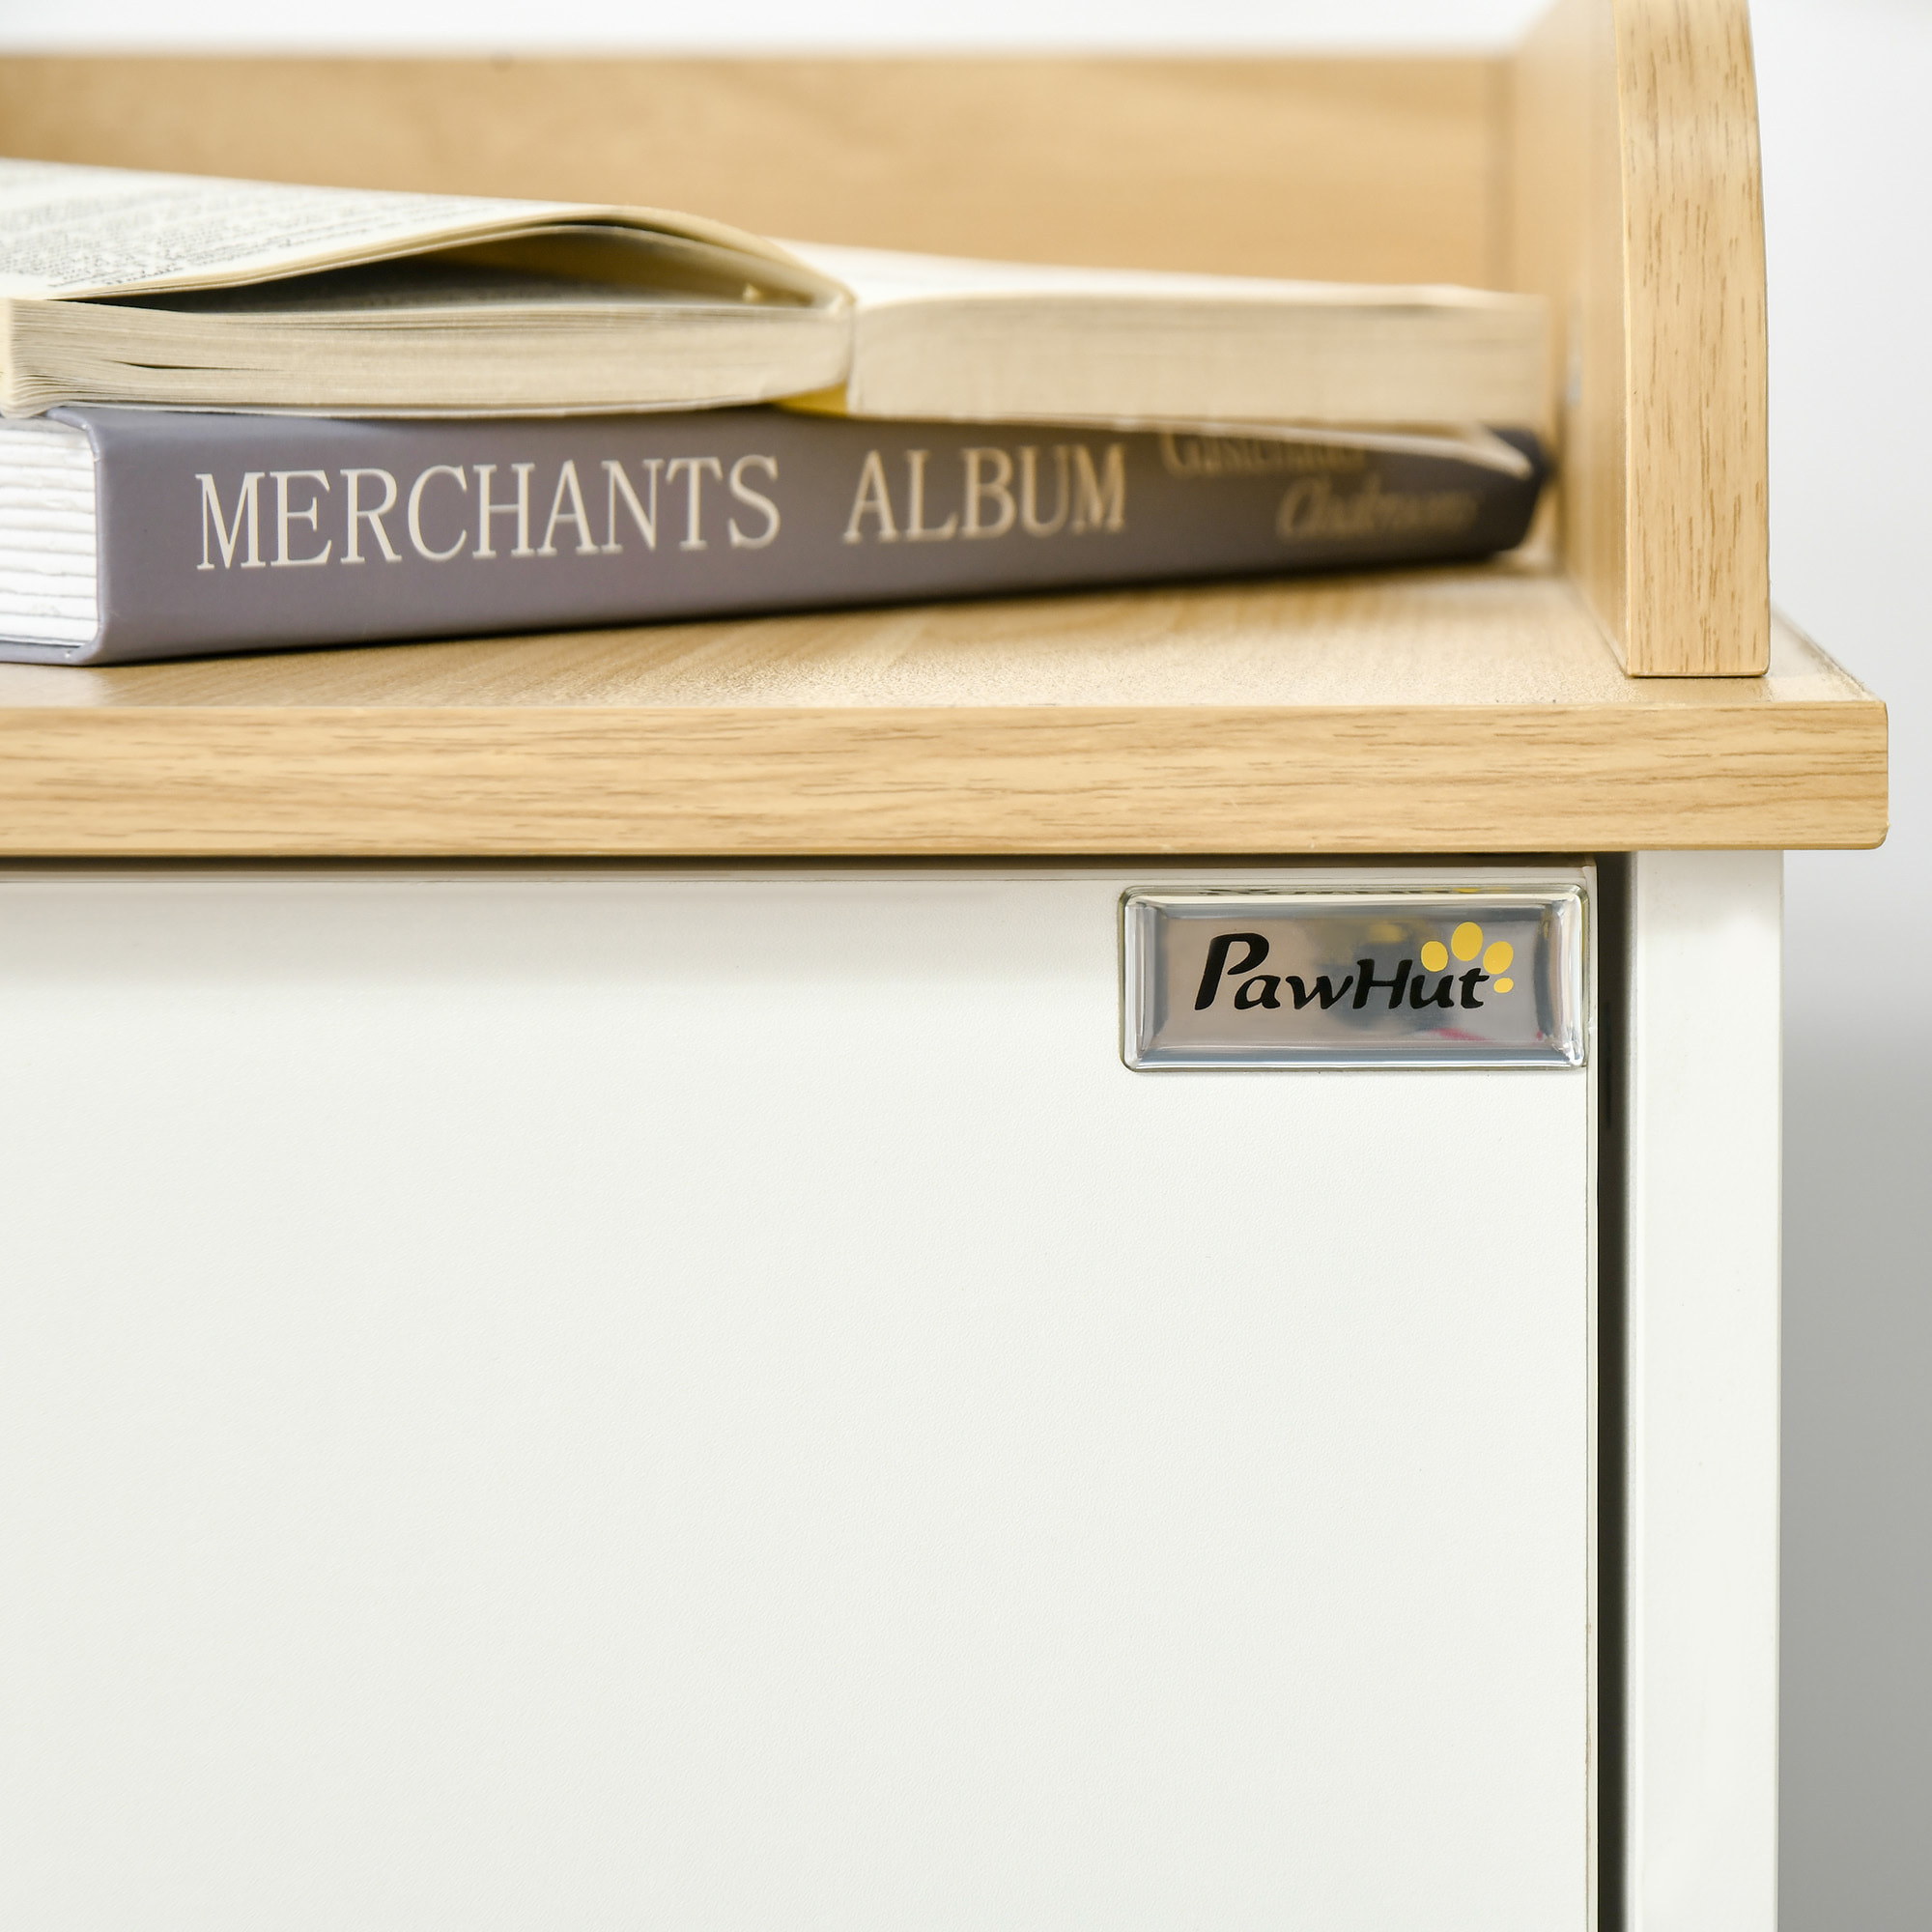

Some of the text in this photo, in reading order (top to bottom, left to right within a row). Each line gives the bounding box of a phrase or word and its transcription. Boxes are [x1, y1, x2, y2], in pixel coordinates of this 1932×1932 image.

[195, 454, 781, 570] MERCHANTS
[842, 443, 1126, 543] ALBUM
[1194, 932, 1490, 1010] PawHut
